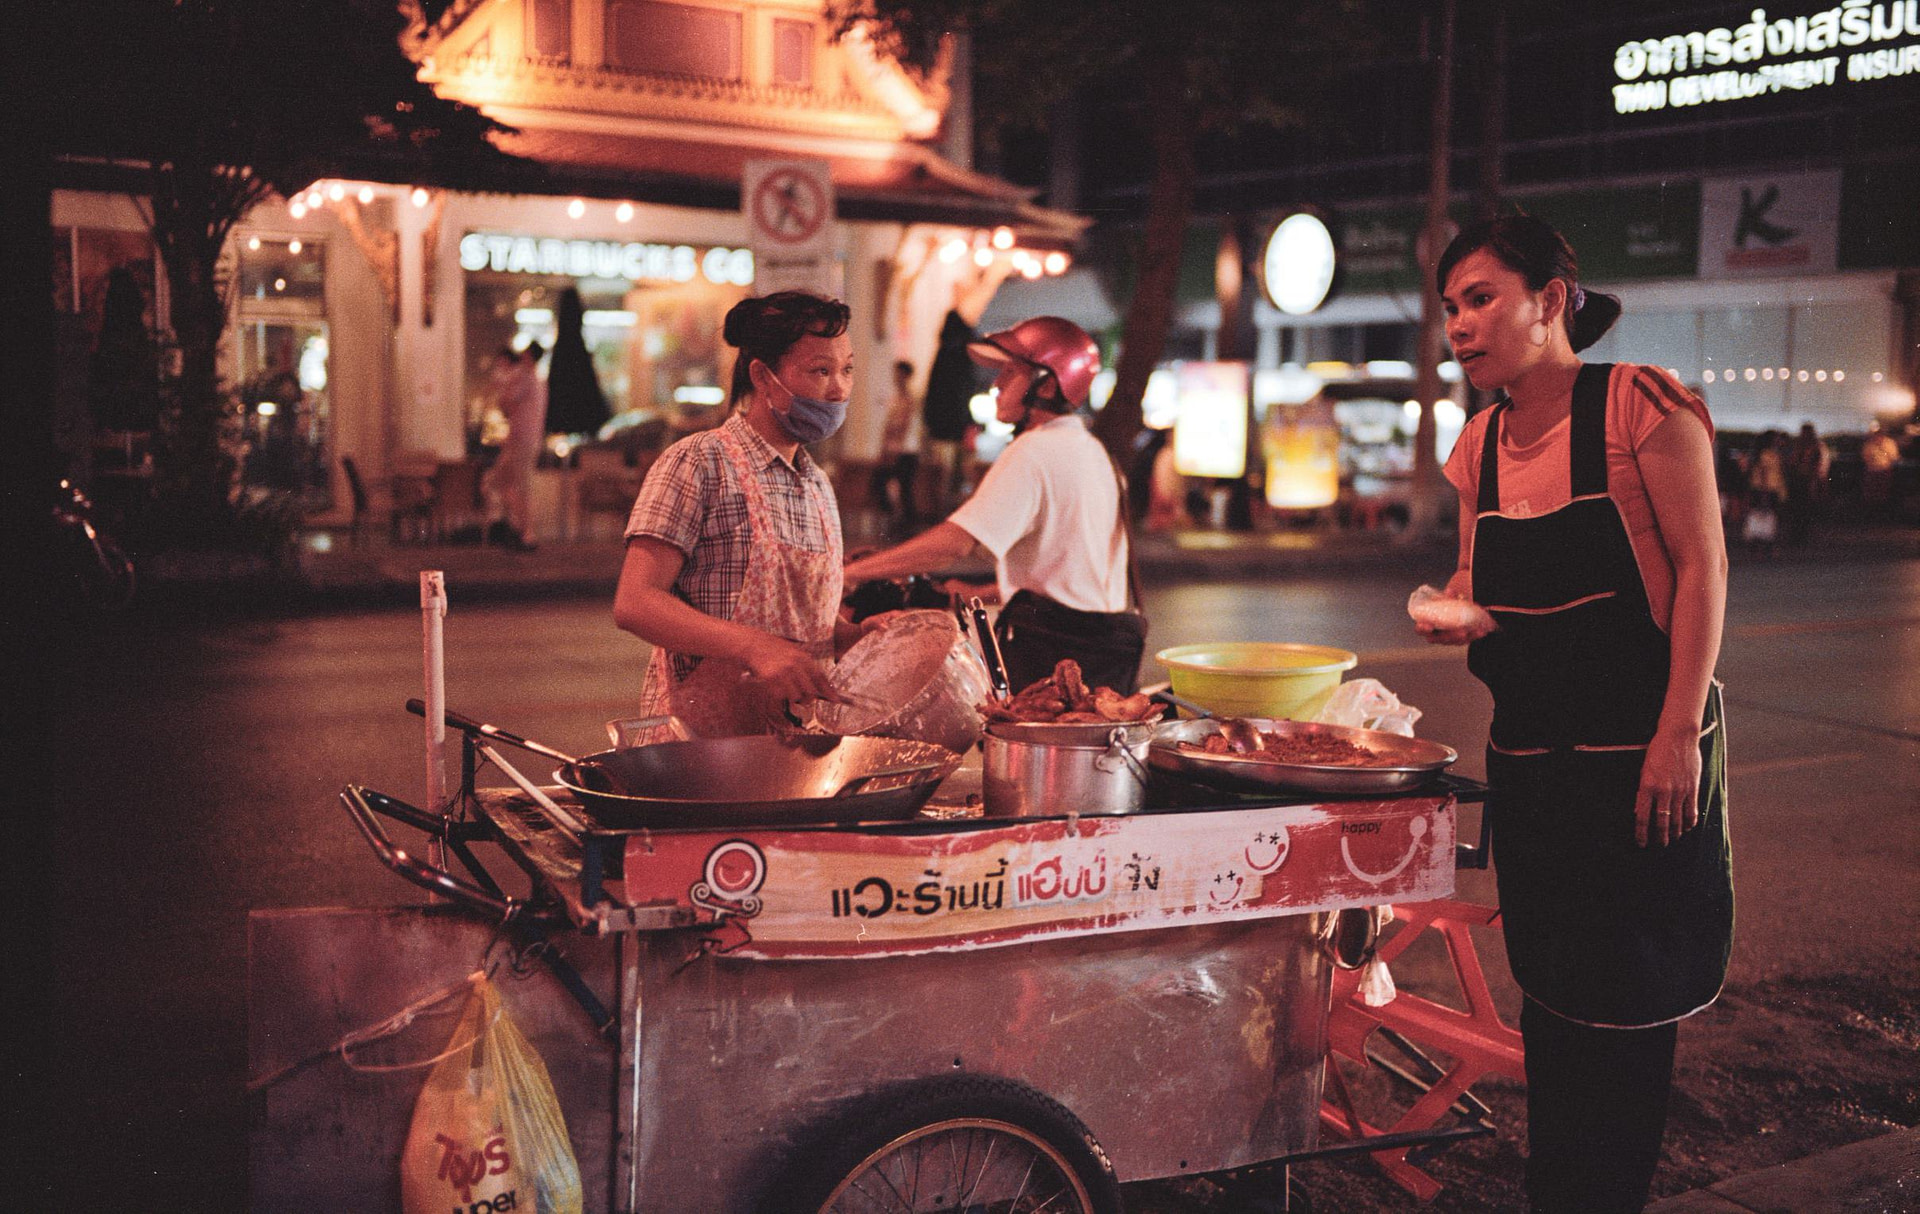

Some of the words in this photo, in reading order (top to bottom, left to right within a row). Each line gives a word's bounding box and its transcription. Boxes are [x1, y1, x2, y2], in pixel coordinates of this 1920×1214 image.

[1612, 79, 1667, 114] THAI
[459, 233, 698, 284] STARBUCKS
[1341, 820, 1383, 837] happy
[831, 857, 1009, 919] แวะร้านนี้
